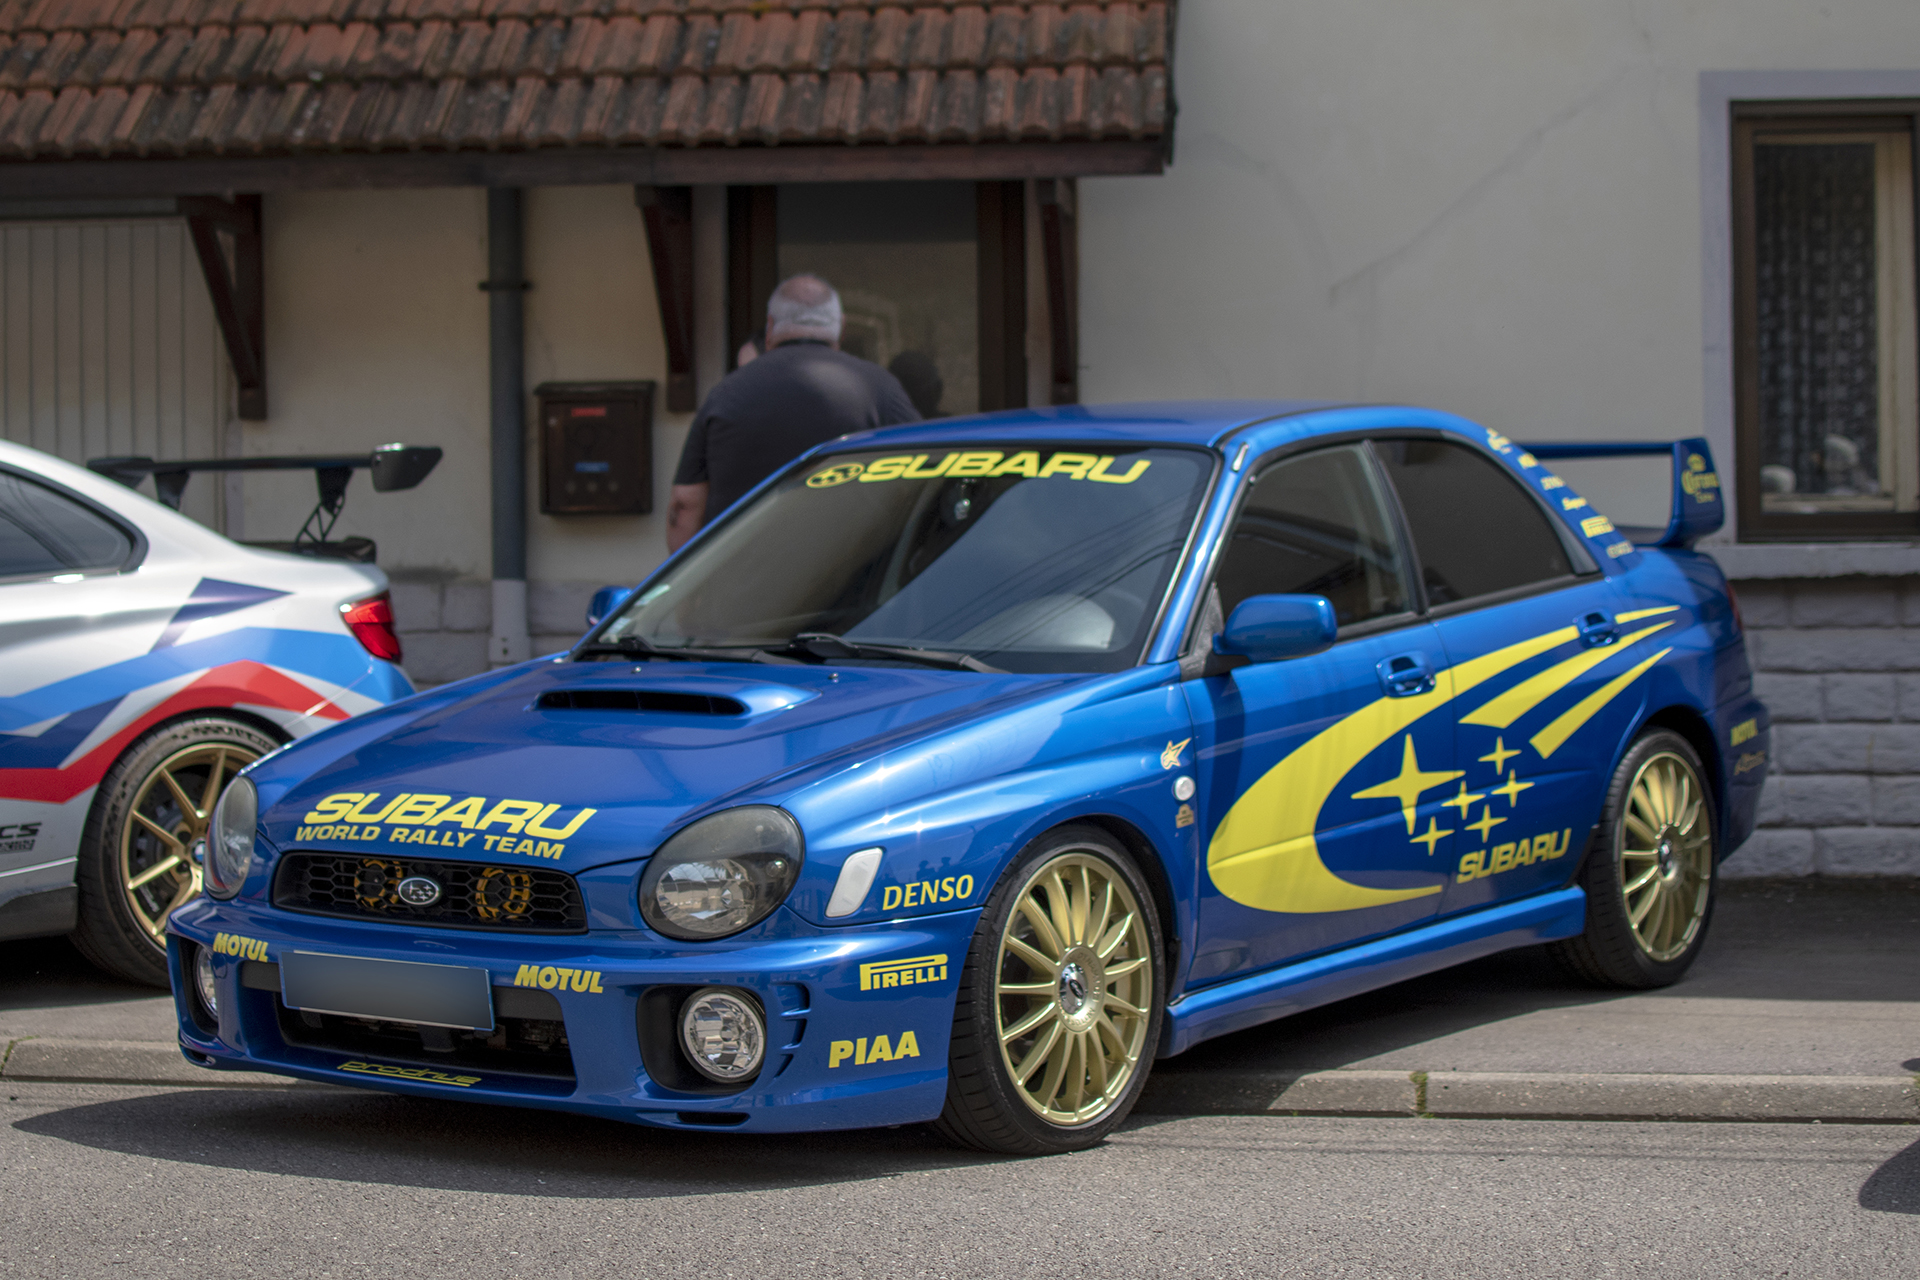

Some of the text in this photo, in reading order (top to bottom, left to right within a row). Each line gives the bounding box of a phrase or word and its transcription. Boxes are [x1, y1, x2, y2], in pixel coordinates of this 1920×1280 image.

[858, 451, 1152, 484] SUBARU
[304, 793, 597, 840] SUBARU
[295, 826, 566, 860] WORLD RALLY TEAM
[1456, 827, 1572, 884] SUBARU
[882, 874, 974, 911] DENSO
[212, 932, 269, 963] MOTUL
[514, 964, 603, 994] MOTUL
[859, 953, 949, 991] PIRELLI
[828, 1030, 921, 1069] PIAA
